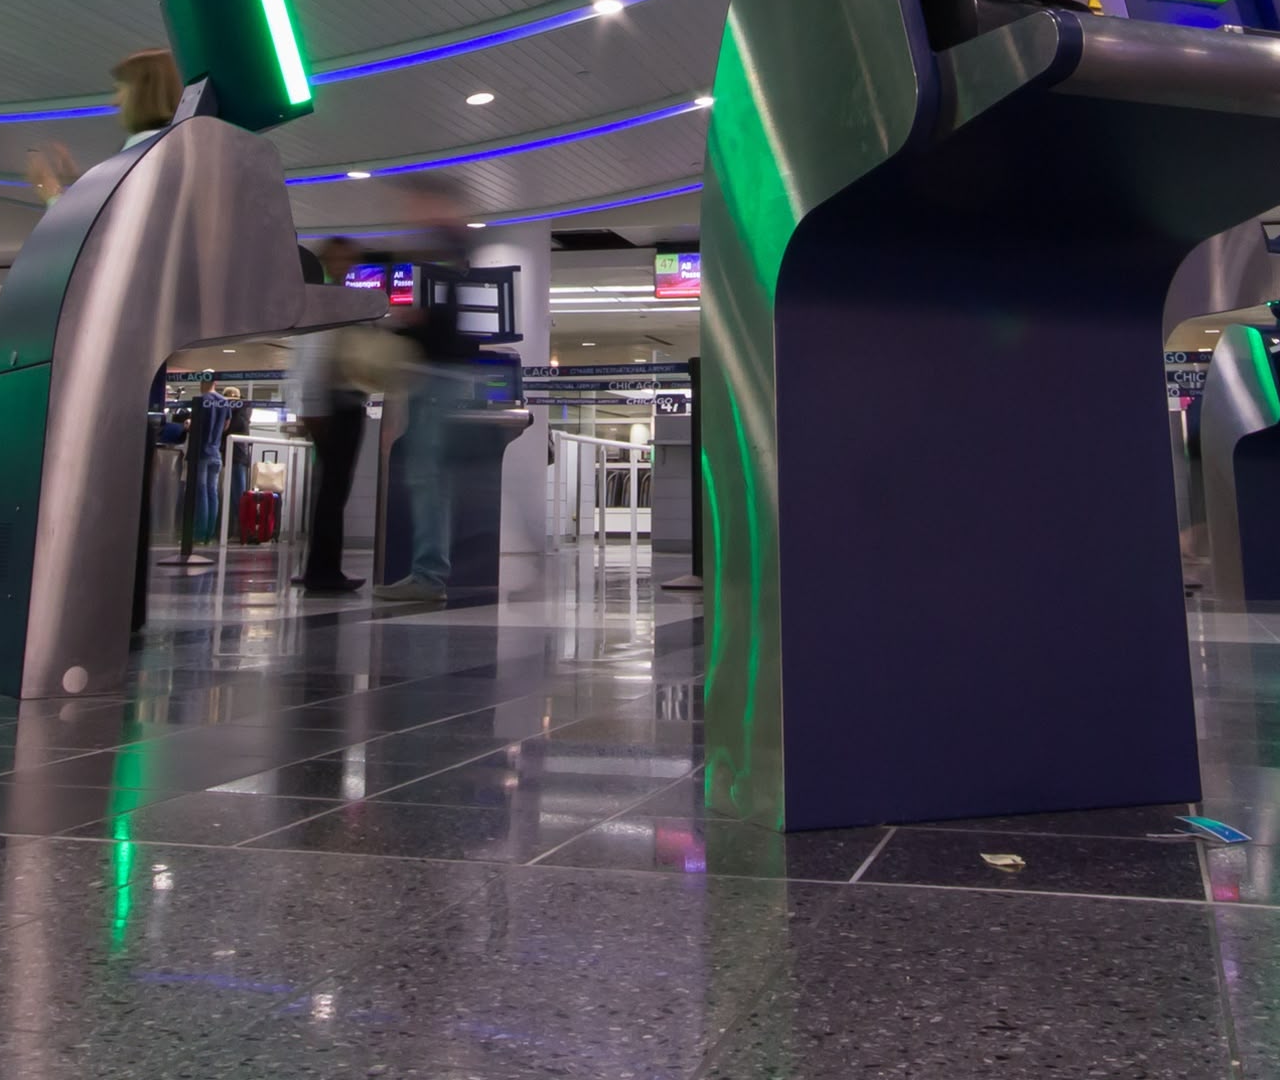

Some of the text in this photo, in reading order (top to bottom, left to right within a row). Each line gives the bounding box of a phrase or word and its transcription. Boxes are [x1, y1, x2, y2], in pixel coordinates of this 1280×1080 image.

[660, 258, 674, 269] 47
[394, 271, 404, 279] All
[167, 372, 213, 381] HICAGO
[523, 367, 560, 377] CAGO
[1174, 371, 1205, 383] CHIC
[608, 380, 662, 390] CHICAGO
[202, 399, 244, 408] CHICAGO
[626, 397, 673, 405] CHICAGO
